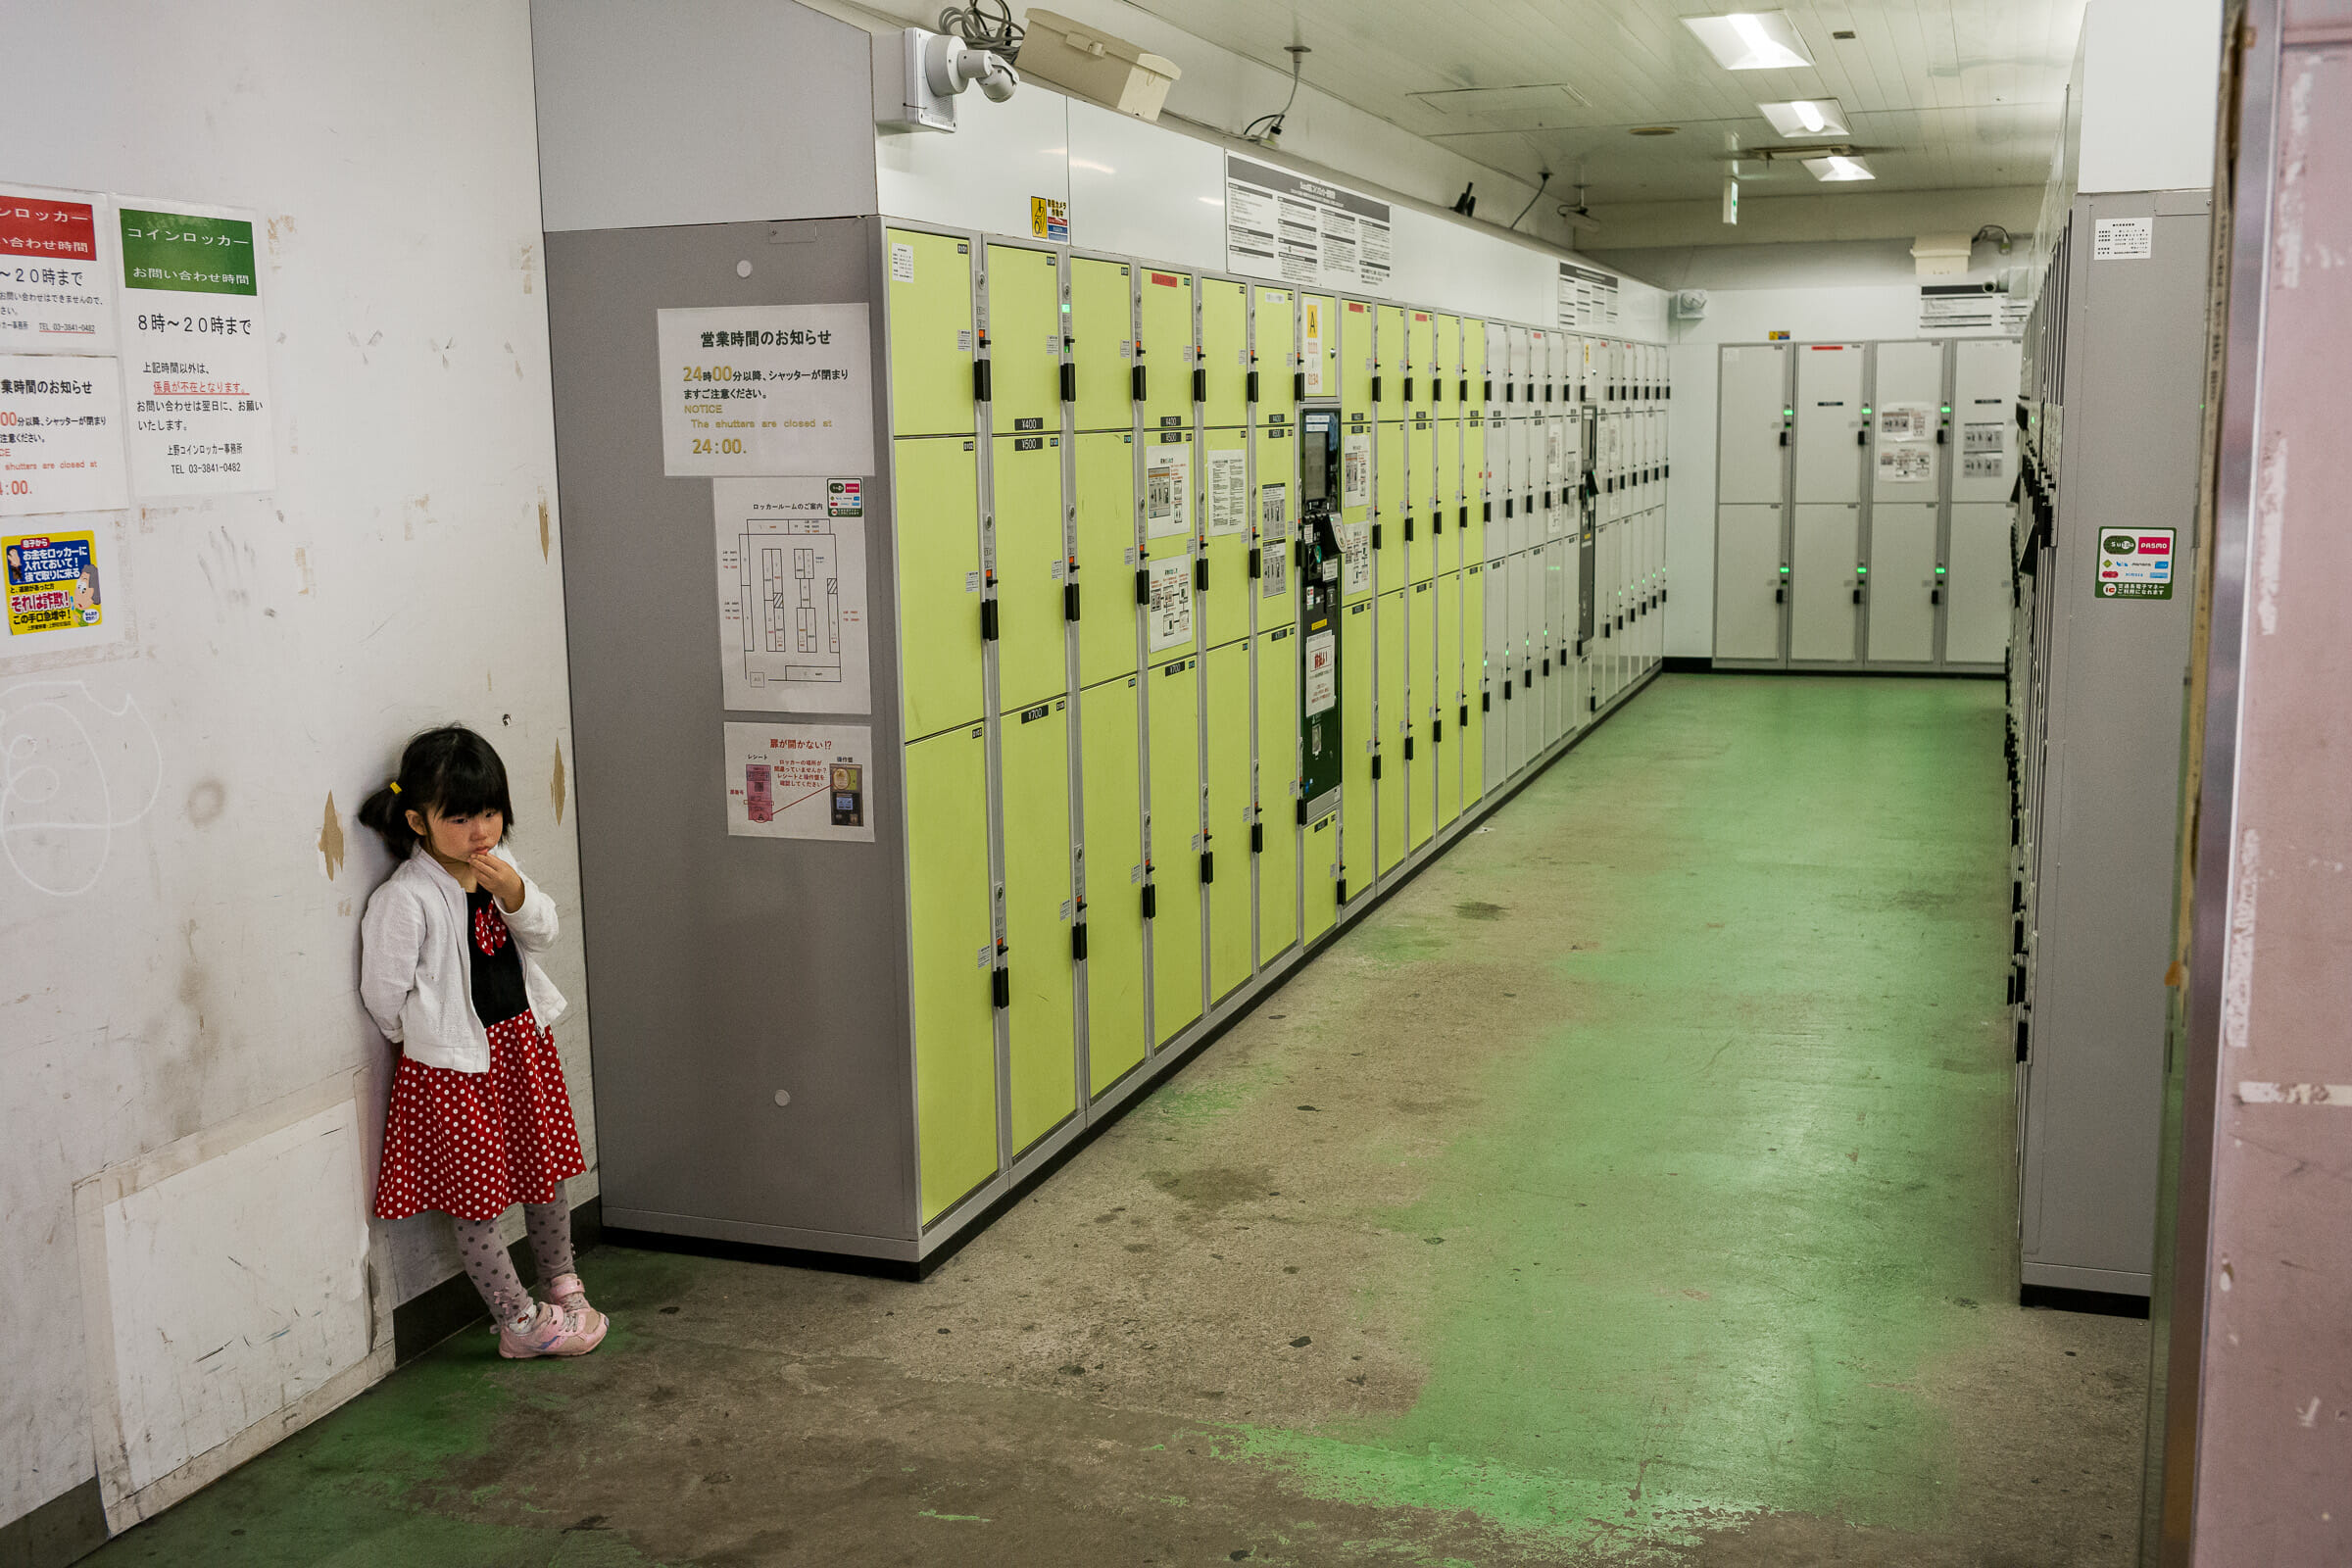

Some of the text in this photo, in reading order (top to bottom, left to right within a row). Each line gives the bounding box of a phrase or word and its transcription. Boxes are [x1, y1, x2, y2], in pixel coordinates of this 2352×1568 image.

[127, 227, 249, 247] コインロッカー
[133, 267, 250, 286] お問い合わせ時間
[1309, 311, 1316, 334] A
[700, 329, 832, 348] 営業時間のお知らせ
[143, 362, 211, 374] 上記時間以外は、
[1, 378, 93, 394] 業時間のお知らせ
[153, 380, 246, 394] 係員が不在となります。
[683, 388, 767, 400] ますご注意ください。
[684, 404, 723, 414] NOTICE
[138, 419, 189, 432] いたします。
[691, 418, 832, 428] The shutters are closed at
[1022, 418, 1037, 429] ¥400
[167, 442, 243, 457] 上野コインロッカー事務所
[692, 438, 747, 454] 24:00.
[42, 462, 56, 470] are
[60, 460, 85, 469] closed
[171, 463, 241, 475] TEL 03-3841-0482
